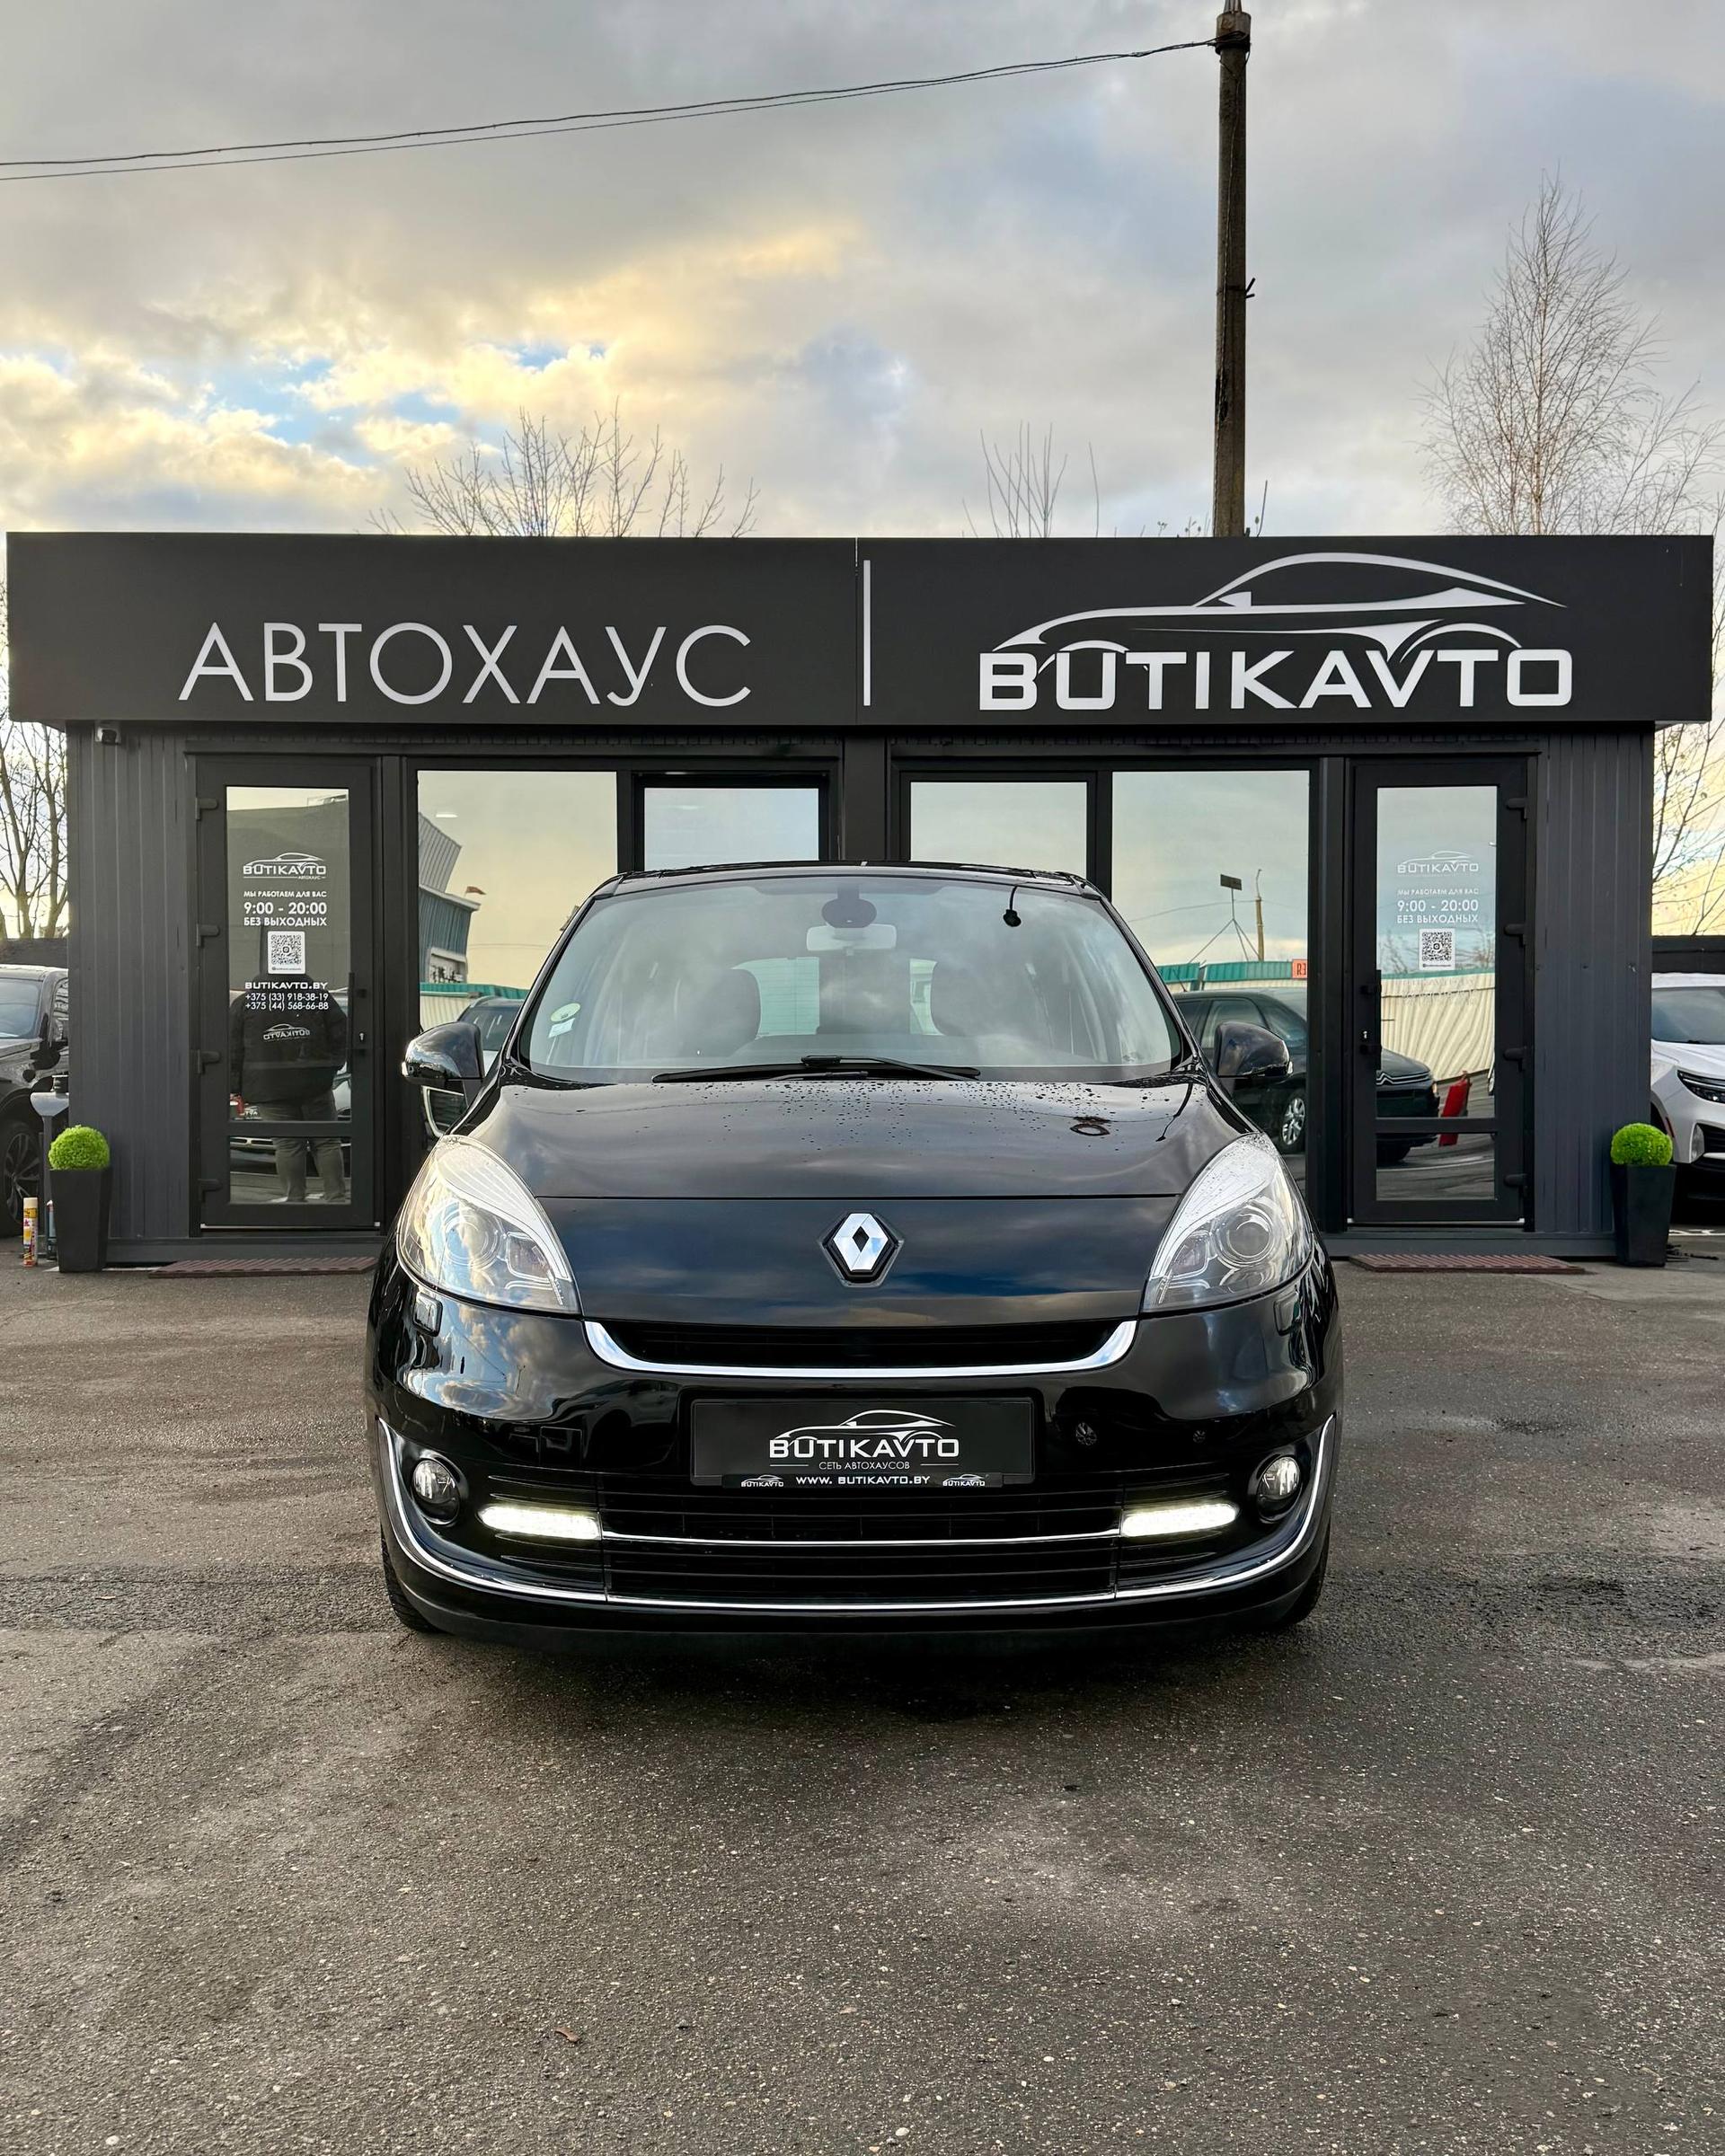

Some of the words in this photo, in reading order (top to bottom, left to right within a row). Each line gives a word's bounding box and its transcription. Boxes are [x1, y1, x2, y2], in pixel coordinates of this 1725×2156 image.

[178, 622, 752, 707] АВТОХАУС
[979, 647, 1572, 711] BUTIKAVTO
[243, 865, 326, 875] BUTIKAVTO
[1397, 862, 1479, 873] BUTIKAVTO
[296, 890, 311, 898] ДЛЯ
[243, 902, 274, 915] 9:00
[288, 902, 327, 915] 20:00
[1397, 899, 1426, 912] 9:00
[1440, 899, 1479, 912] 20:00
[243, 917, 261, 926] БЕЗ
[263, 916, 328, 928] ВЫХОДНЫХ
[1396, 915, 1414, 924] БЕЗ
[1417, 914, 1478, 924] ВЫХОДНЫХ
[244, 982, 329, 990] BUTIKAVTO.BY
[244, 993, 267, 1001] +375
[269, 992, 285, 1002] (33)
[287, 993, 329, 1001] 918-38-19
[245, 1002, 267, 1010] +375
[269, 1002, 285, 1012] (44)
[287, 1002, 329, 1010] 568-66-88
[769, 1439, 960, 1458] BUTIKAVTO
[818, 1462, 842, 1470] СЕТЬ
[844, 1461, 911, 1470] АВТОХАУСОВ
[837, 1475, 931, 1485] BUTIKAVTO.BY
